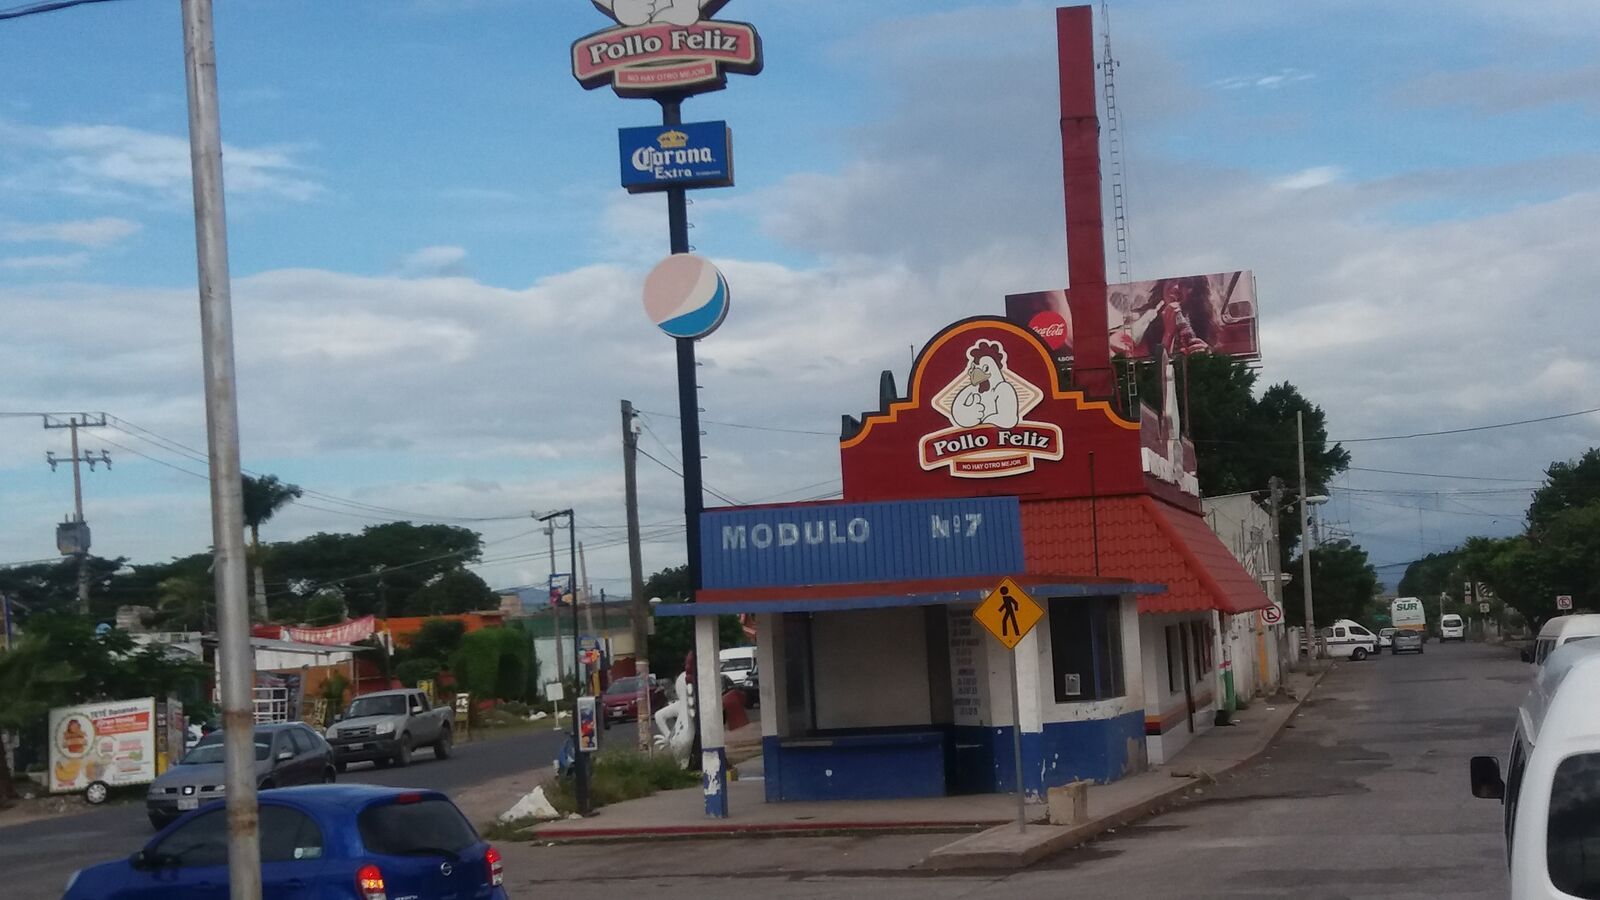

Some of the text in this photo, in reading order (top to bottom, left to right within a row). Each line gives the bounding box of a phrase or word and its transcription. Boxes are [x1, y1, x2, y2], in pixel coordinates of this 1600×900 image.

[589, 29, 737, 65] Pollo Feliz
[656, 71, 679, 80] OTRO
[631, 146, 713, 173] Corona
[655, 166, 693, 180] Extra
[933, 431, 1050, 456] Pollo Feliz
[1001, 459, 1022, 468] MEJOR
[721, 517, 870, 550] MODULO
[1396, 603, 1418, 611] SUR
